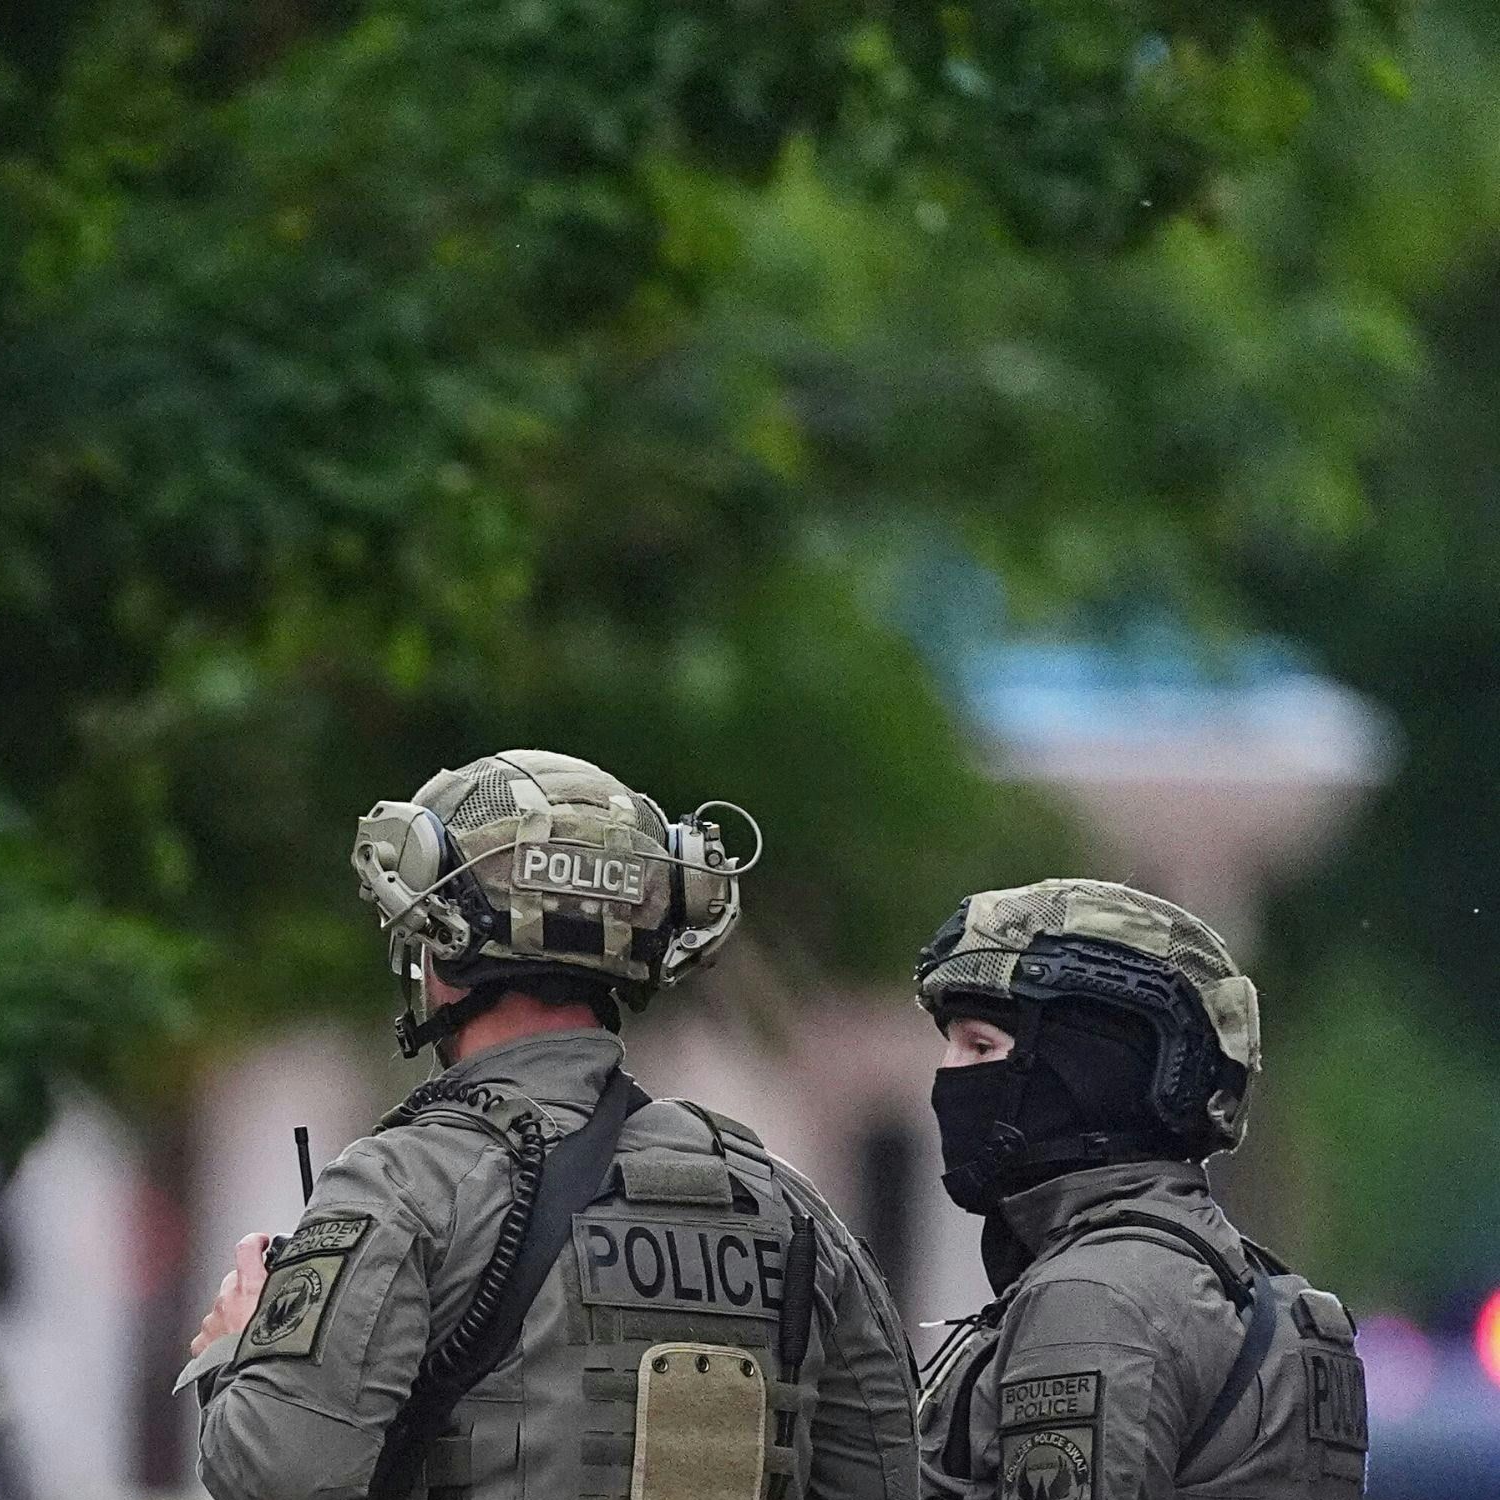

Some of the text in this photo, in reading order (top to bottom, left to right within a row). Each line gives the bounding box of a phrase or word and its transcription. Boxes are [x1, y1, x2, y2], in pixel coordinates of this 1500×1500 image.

[524, 849, 640, 896] POLICE
[288, 1235, 345, 1254] POLICE
[586, 1224, 785, 1311] POLICE
[1005, 1377, 1090, 1404] BOULDER
[1014, 1397, 1078, 1420] POLICE
